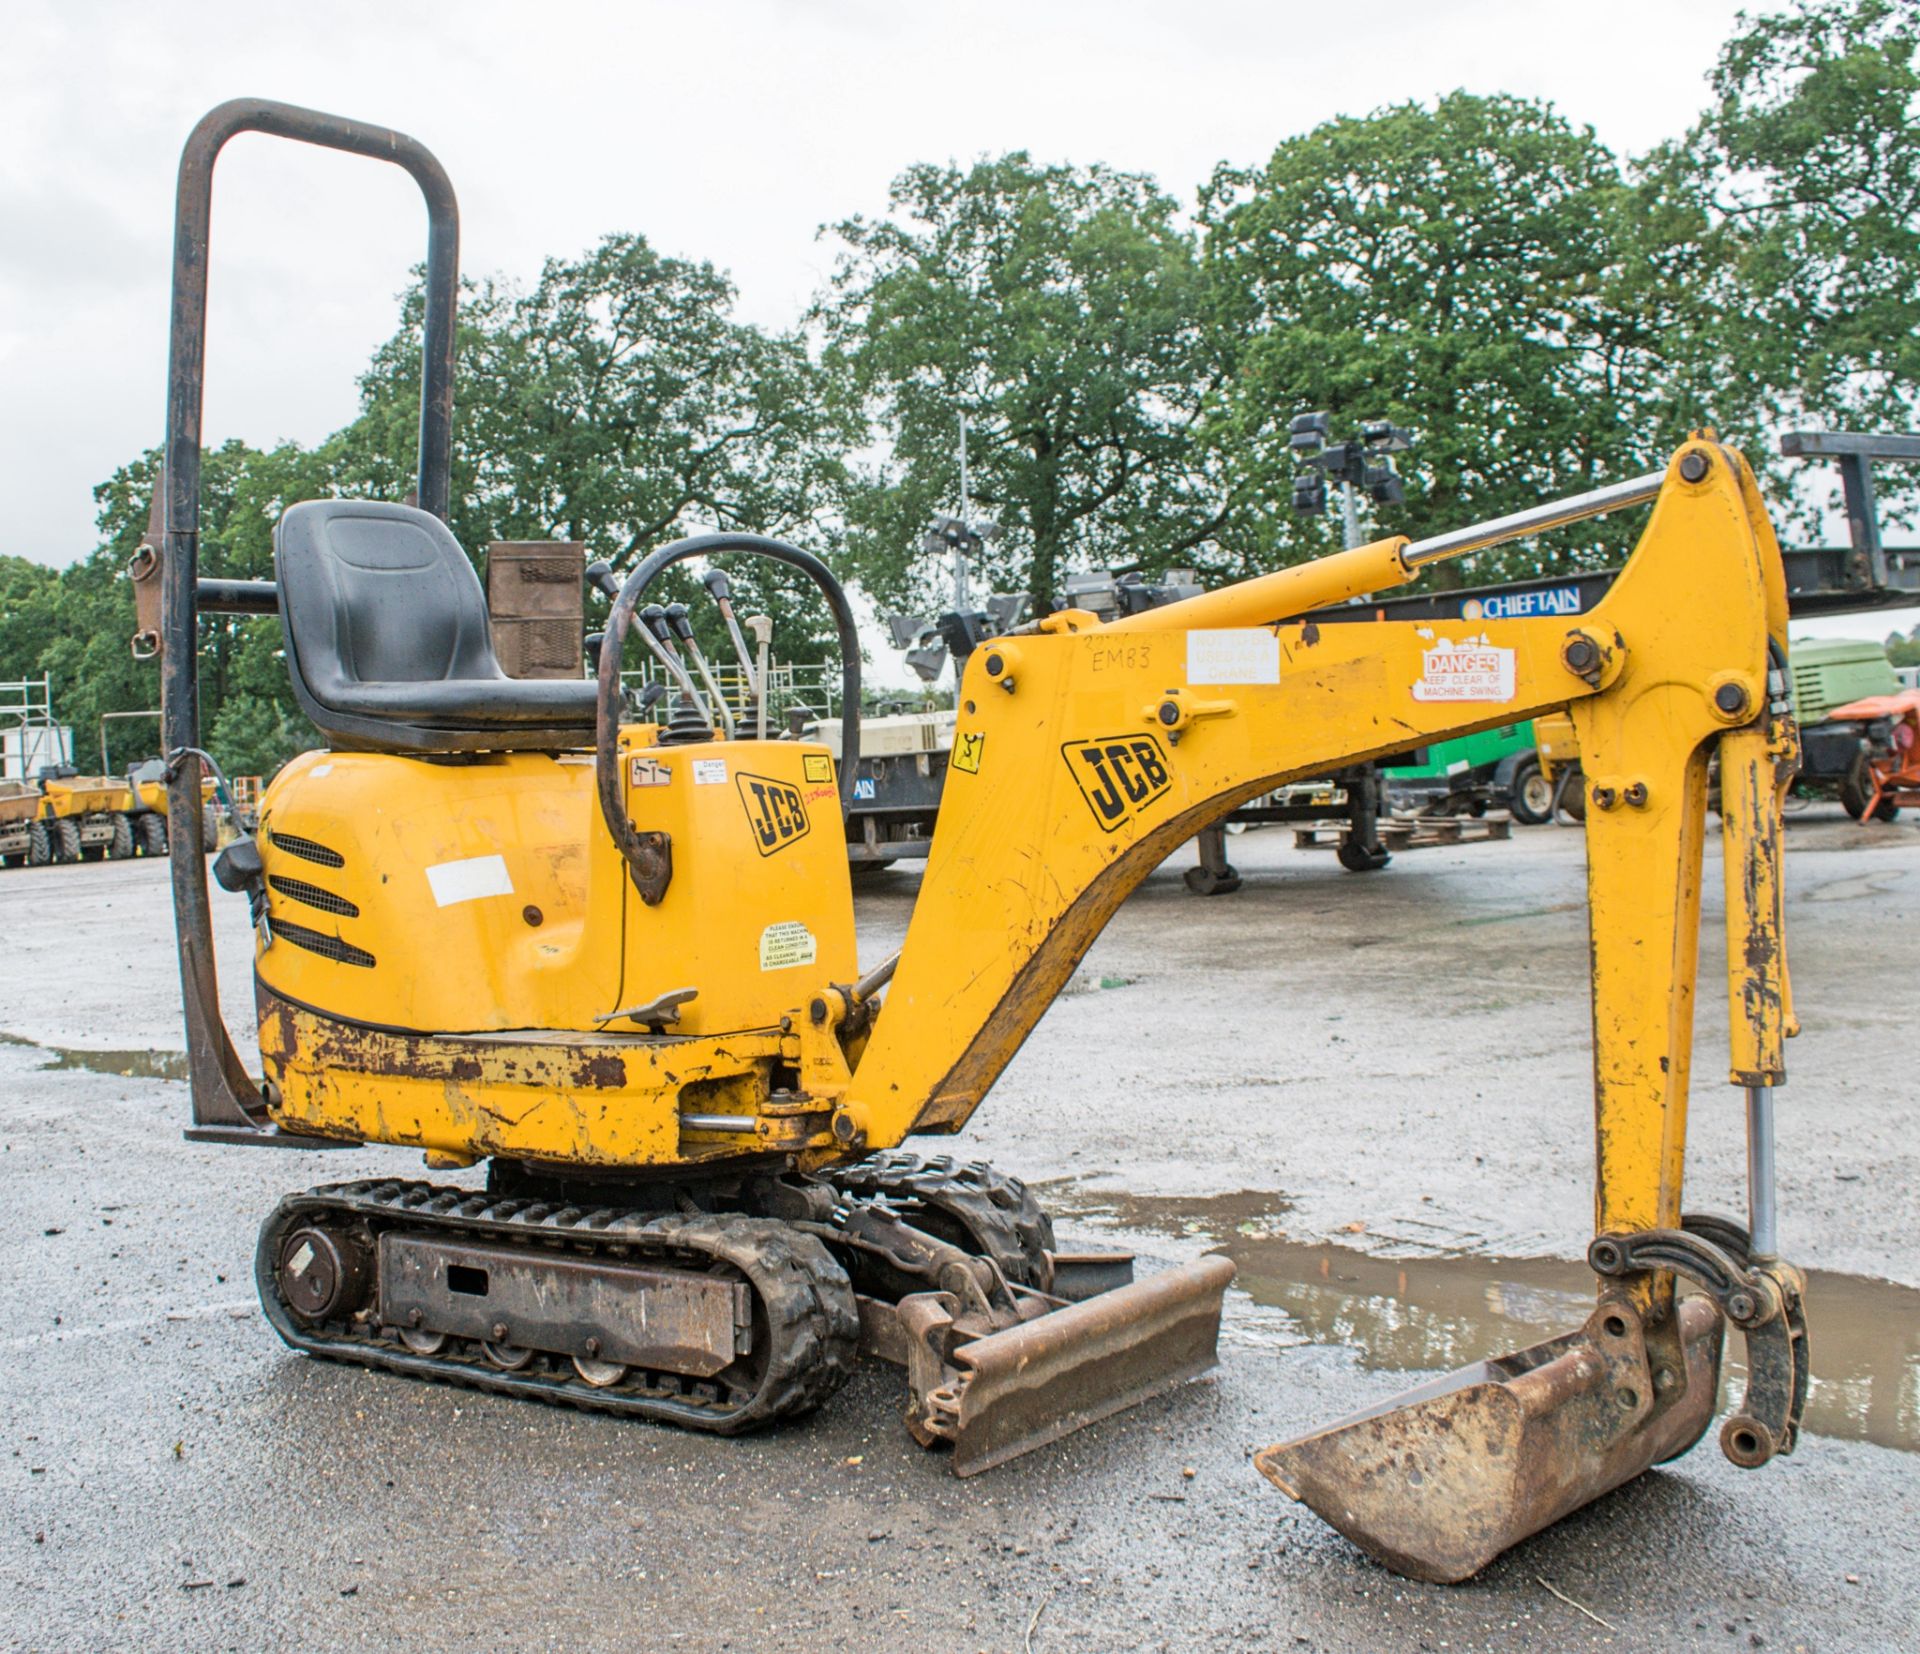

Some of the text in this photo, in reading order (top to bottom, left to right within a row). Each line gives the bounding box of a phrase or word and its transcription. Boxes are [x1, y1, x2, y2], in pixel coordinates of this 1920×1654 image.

[1484, 587, 1580, 618] CHIEFTAIN
[1427, 654, 1500, 674] DANGER
[1424, 674, 1502, 685] KEEP CLEAR OF
[1424, 687, 1465, 697] MACHINE
[1080, 741, 1169, 820] JCB
[749, 781, 807, 847] JCB
